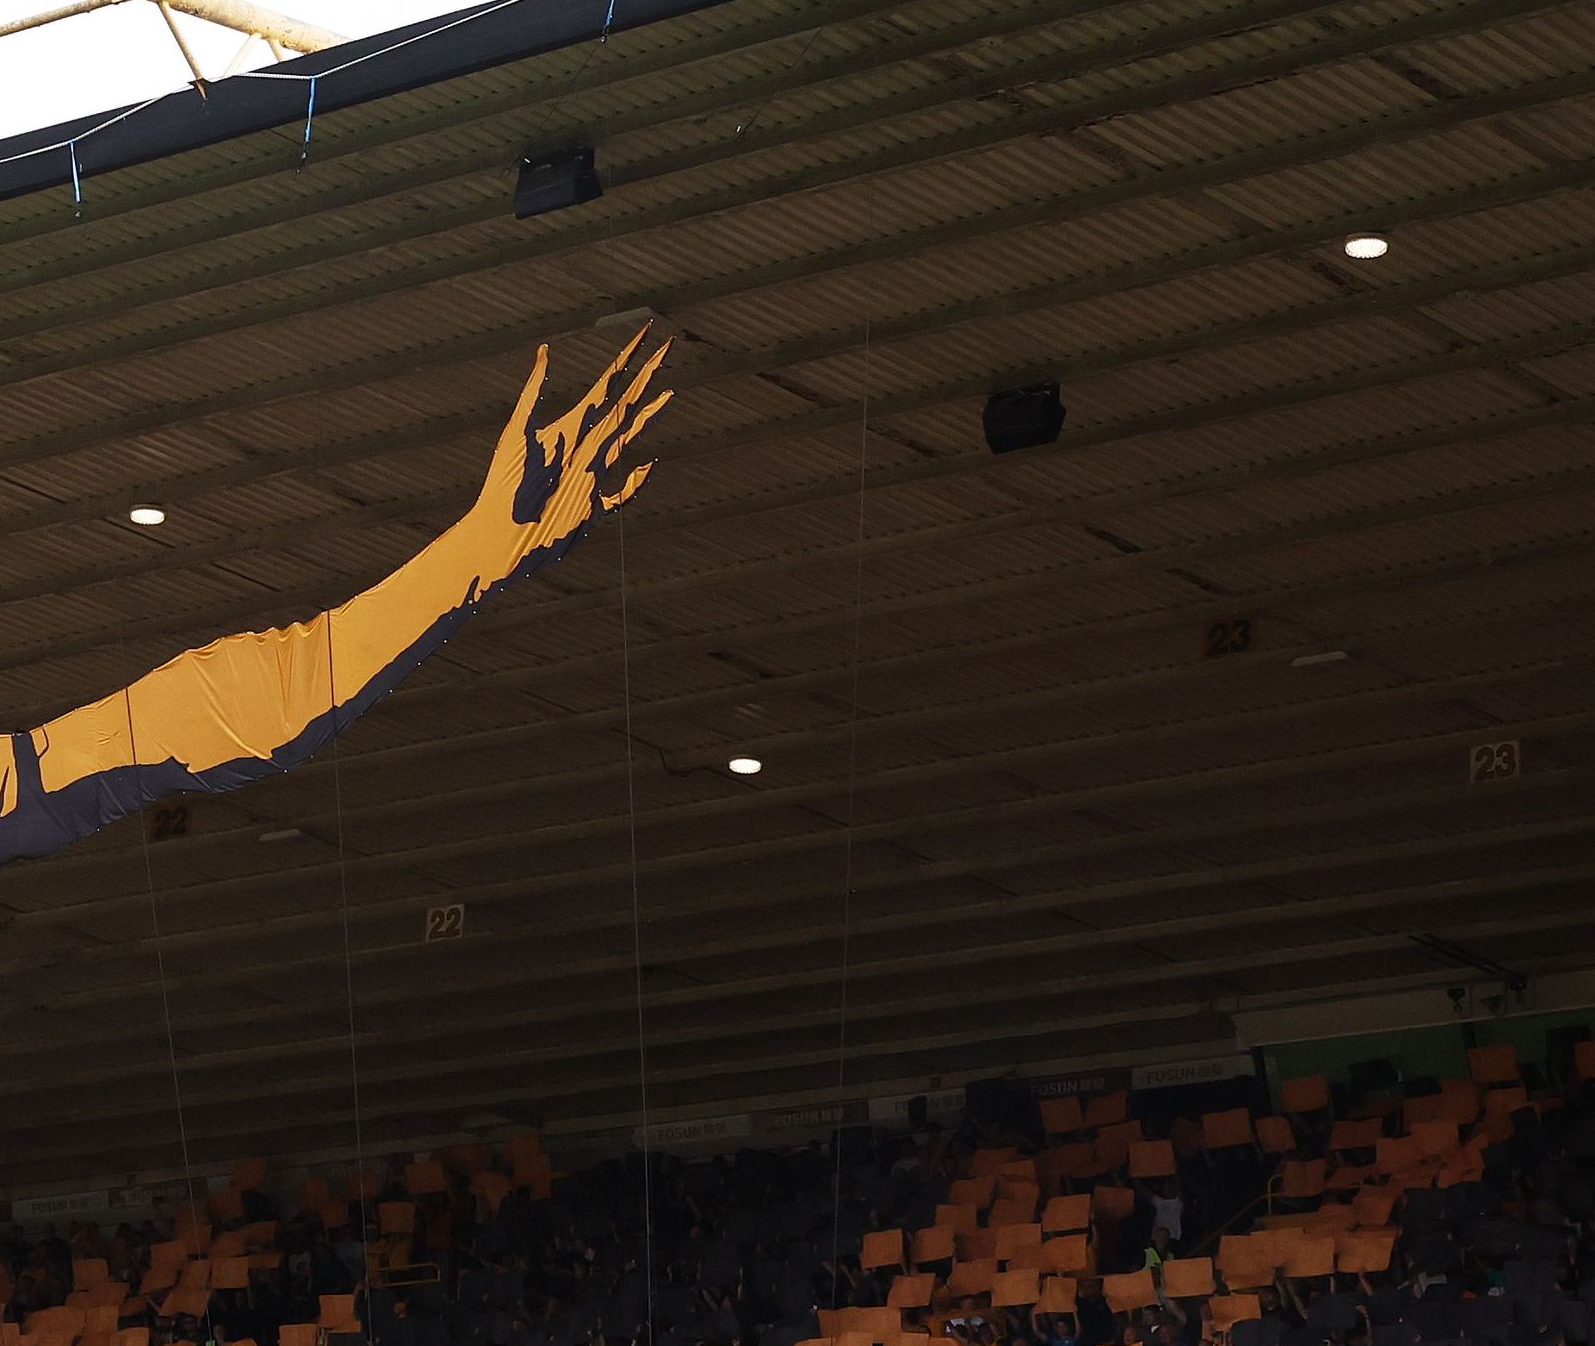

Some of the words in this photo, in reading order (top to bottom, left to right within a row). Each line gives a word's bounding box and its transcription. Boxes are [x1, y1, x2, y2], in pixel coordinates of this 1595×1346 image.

[1208, 618, 1251, 655] 23
[1474, 743, 1516, 781] 23
[153, 807, 189, 841] 22
[428, 907, 461, 939] 22
[1030, 1079, 1078, 1097] FOSUN
[1147, 1066, 1196, 1084] FOSUN
